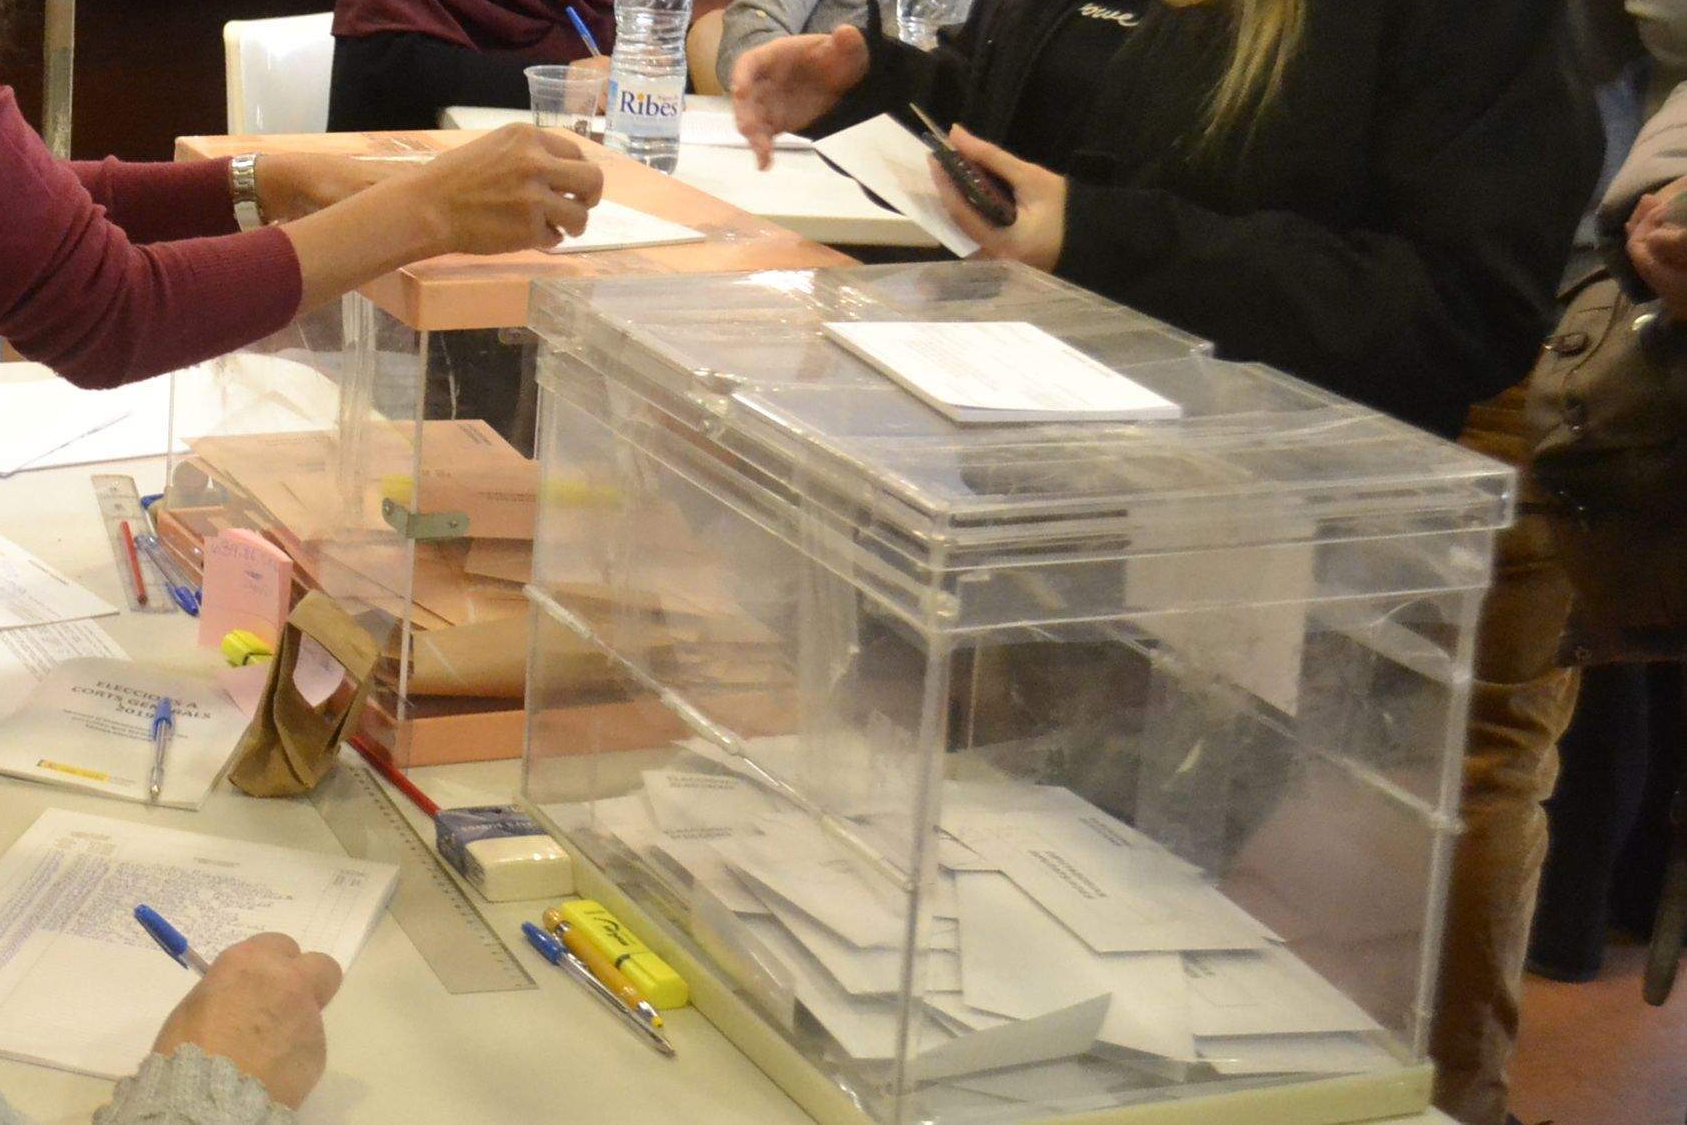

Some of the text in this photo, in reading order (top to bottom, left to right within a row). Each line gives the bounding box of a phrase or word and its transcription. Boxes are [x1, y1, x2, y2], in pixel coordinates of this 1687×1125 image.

[620, 90, 678, 117] Ribes
[71, 686, 211, 719] CORTS GENRALS
[95, 681, 182, 706] ELECCIOS
[114, 703, 155, 719] 2019
